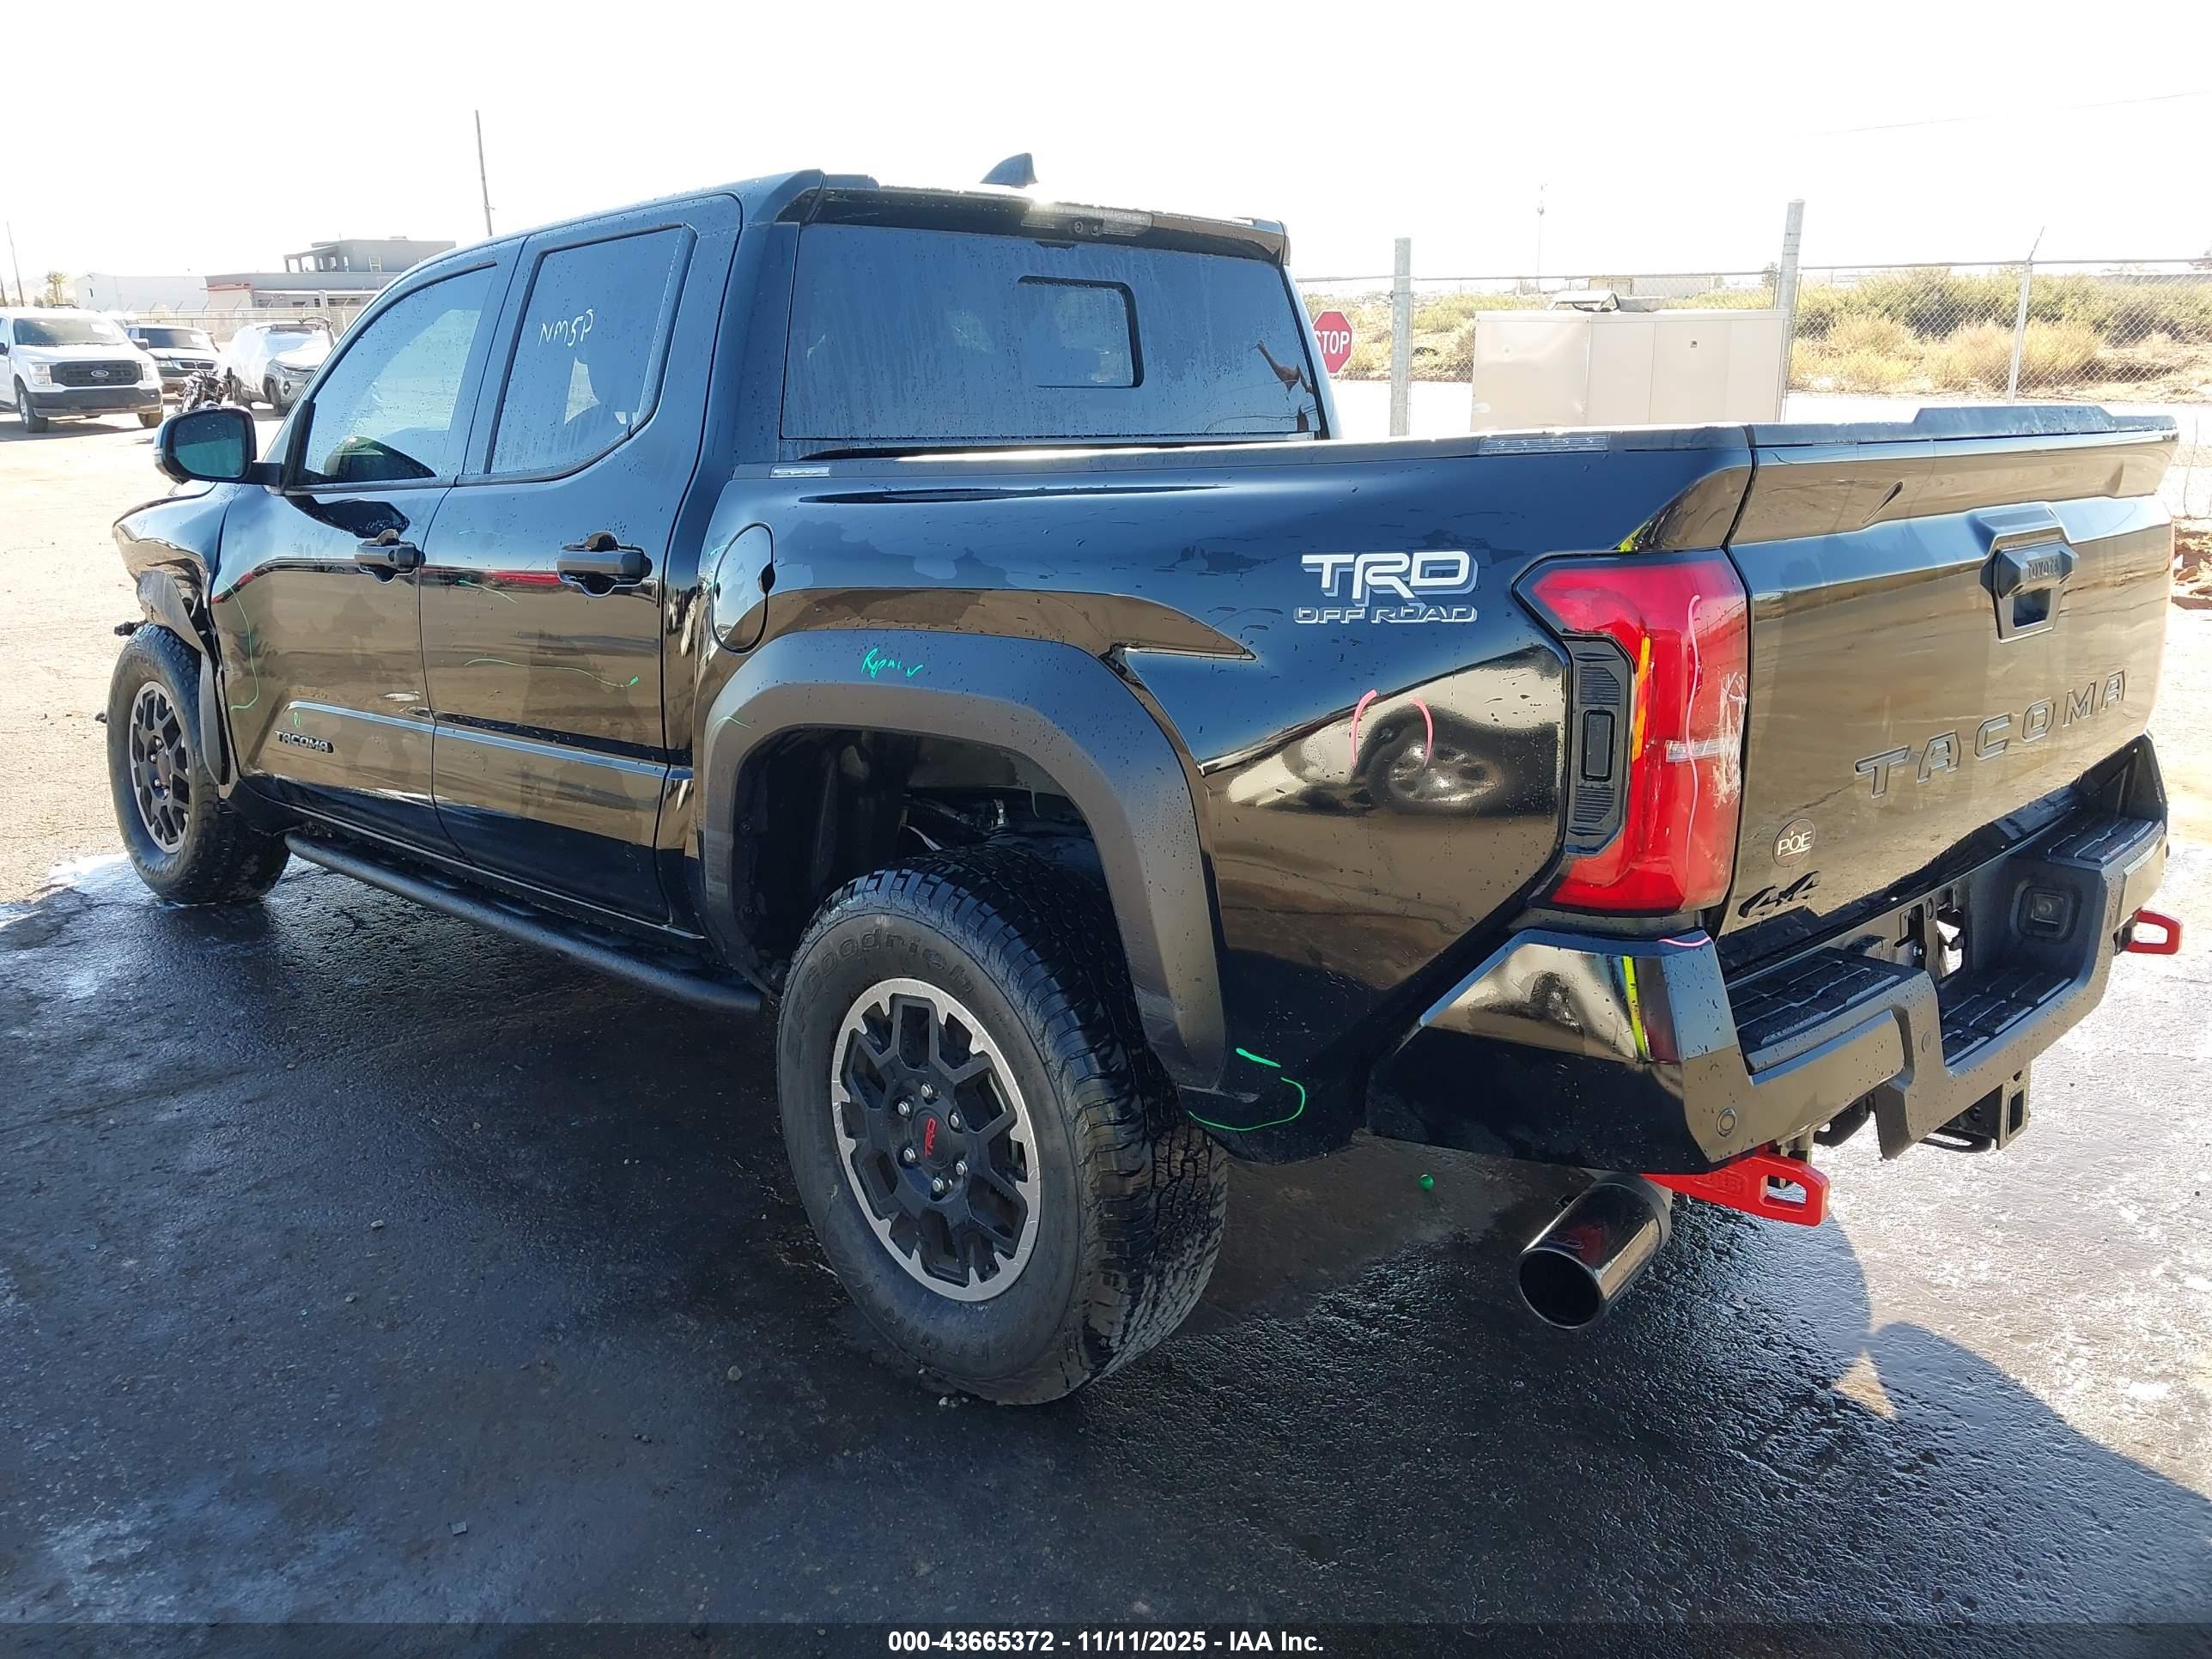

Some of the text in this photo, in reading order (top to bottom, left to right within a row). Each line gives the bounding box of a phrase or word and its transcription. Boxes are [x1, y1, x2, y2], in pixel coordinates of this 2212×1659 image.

[1302, 551, 1477, 605] TRD
[1294, 605, 1478, 624] OFF ROAD
[274, 730, 331, 753] TACOMA
[1855, 669, 2126, 799] TACOMA
